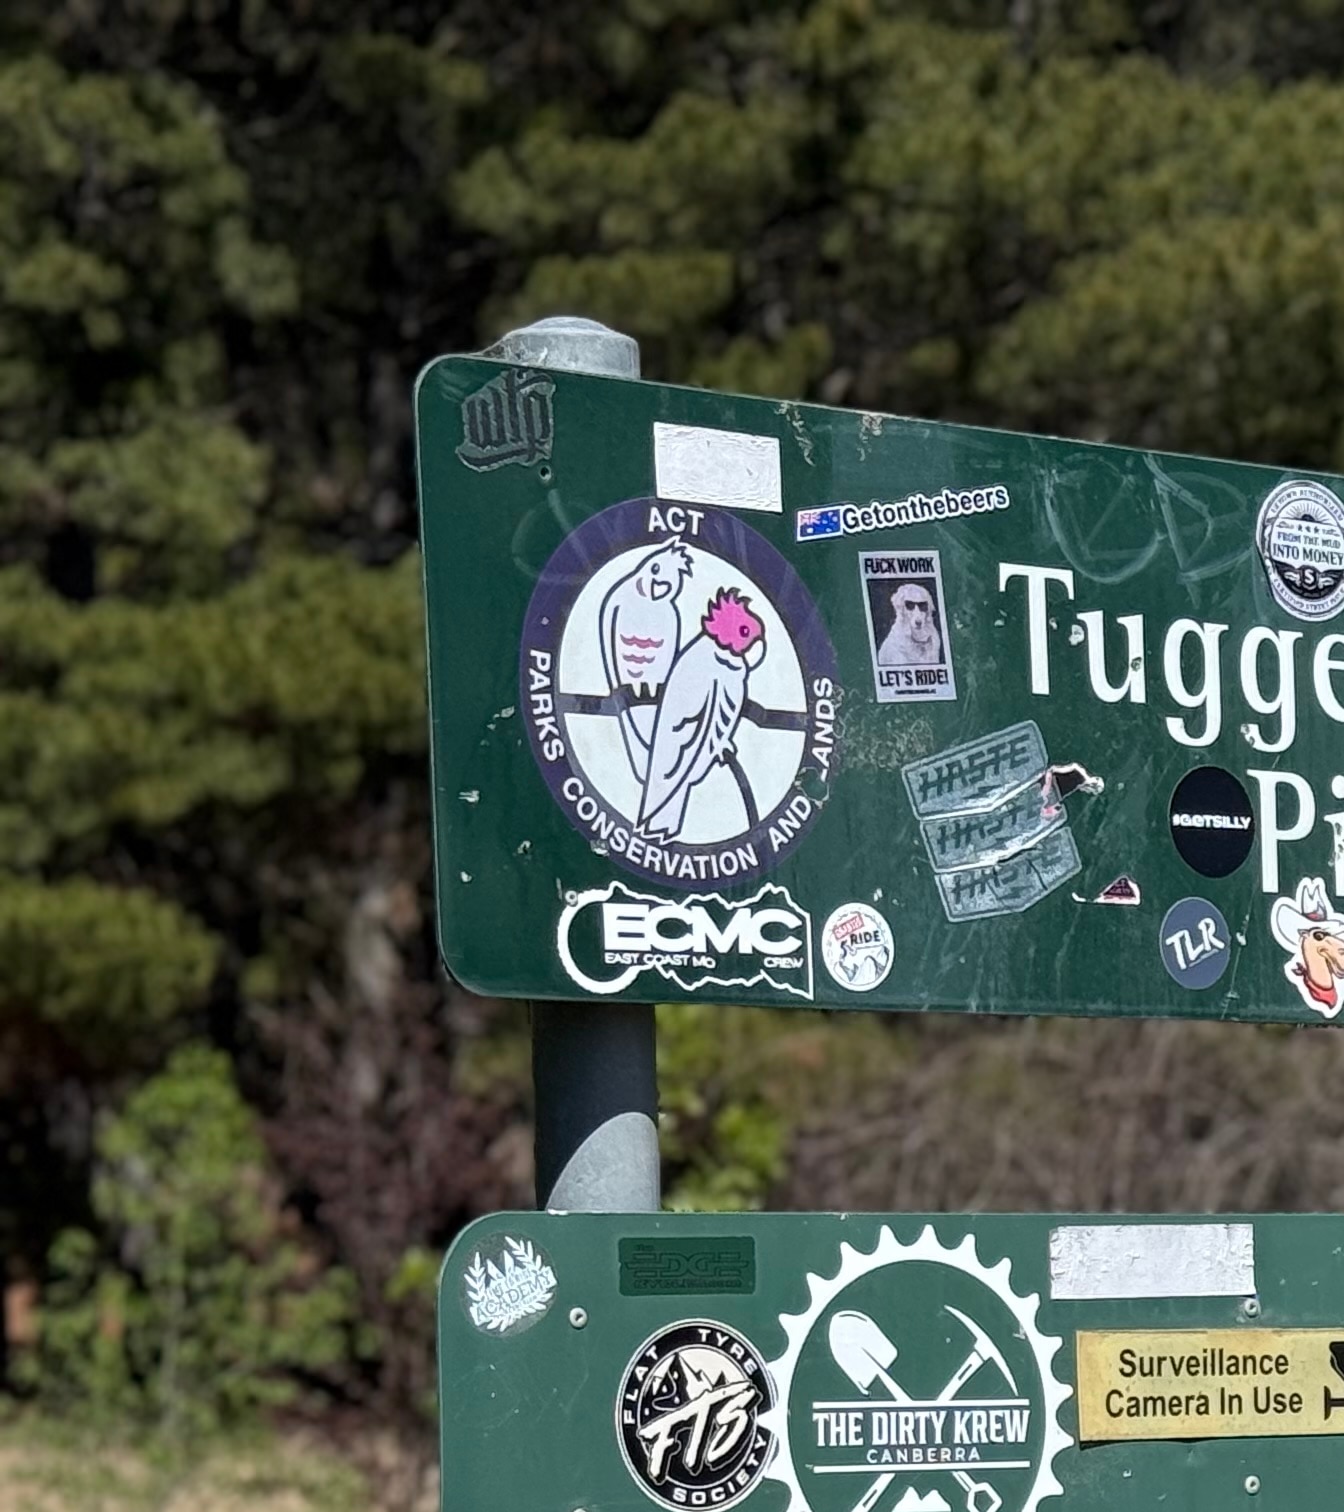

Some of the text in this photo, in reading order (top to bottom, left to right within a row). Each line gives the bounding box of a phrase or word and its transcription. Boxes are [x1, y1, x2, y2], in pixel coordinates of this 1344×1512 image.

[647, 508, 705, 537] ACT
[842, 487, 1008, 529] Getonthebeers
[864, 556, 935, 575] FUCK WORK
[1273, 543, 1344, 566] INTO MONEY
[879, 668, 949, 687] LET'S RIDE!
[529, 649, 836, 880] PARKS CONSERVATION AND ANDS
[602, 902, 802, 955] ECMC
[850, 930, 881, 946] RIDE
[1165, 917, 1225, 970] TLR
[604, 953, 640, 965] EAST
[763, 956, 805, 969] CREW
[623, 1327, 759, 1425] FLAT TYRE
[1118, 1348, 1290, 1378] Surveillance
[1105, 1386, 1303, 1419] Camera In Use
[637, 1380, 758, 1484] FTS
[813, 1408, 1030, 1447] THE DIRTY KREW
[672, 1435, 768, 1503] SOCIETY
[866, 1447, 980, 1464] CANBERRA
